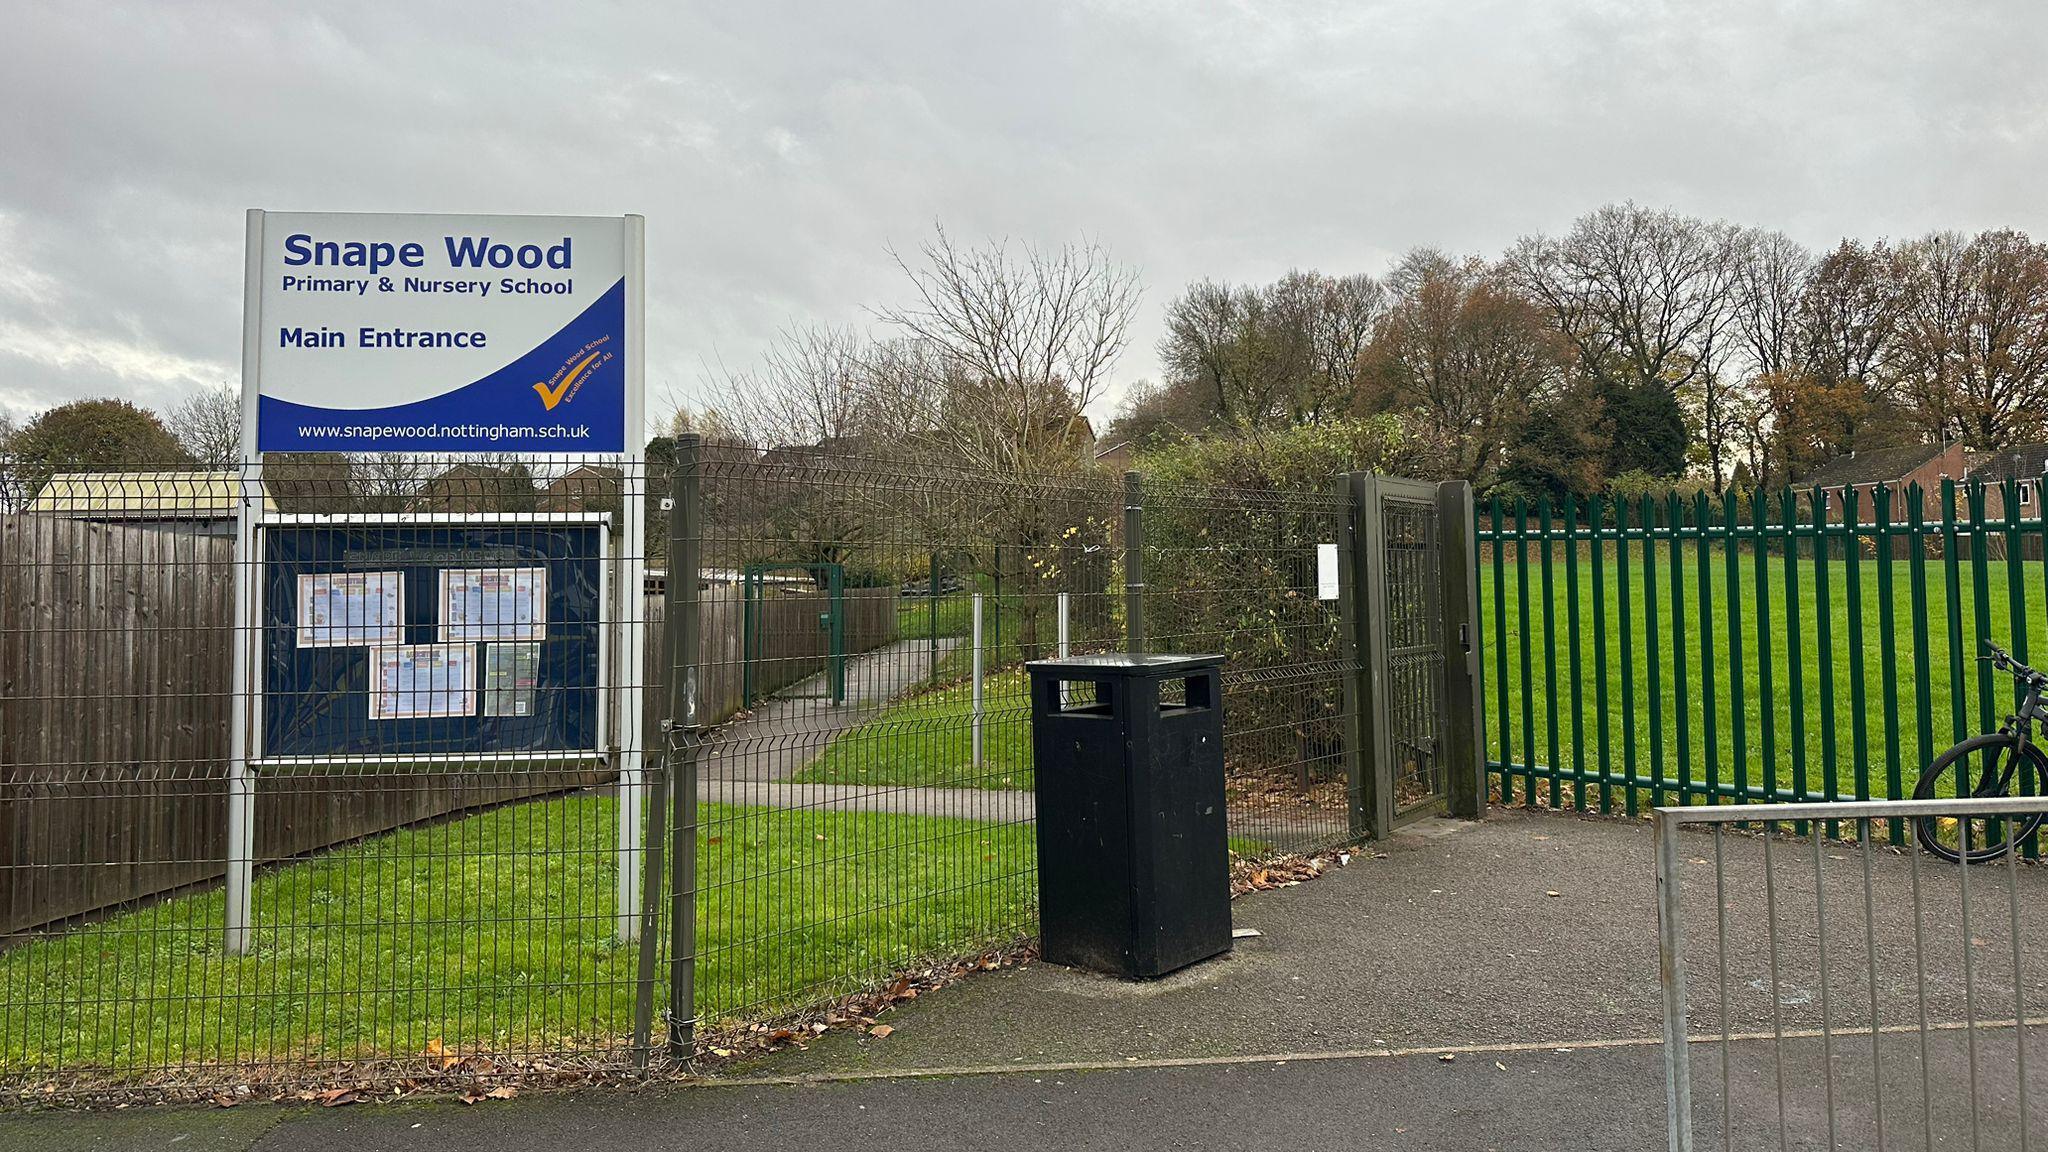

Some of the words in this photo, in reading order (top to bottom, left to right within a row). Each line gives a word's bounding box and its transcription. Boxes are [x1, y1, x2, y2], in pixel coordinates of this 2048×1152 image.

[283, 234, 425, 274] Snape
[444, 236, 572, 269] Wood
[282, 275, 369, 296] Primary
[378, 276, 395, 293] &
[404, 277, 491, 297] Nursery
[500, 277, 573, 295] School
[280, 327, 345, 348] Main
[359, 327, 487, 348] Entrance
[548, 365, 567, 386] Snape
[565, 348, 585, 366] Wood
[585, 334, 610, 351] School
[565, 370, 593, 403] Excellence
[592, 361, 602, 370] for
[602, 352, 613, 362] All
[298, 423, 590, 441] www.snapewood.nottingham.sch.uk
